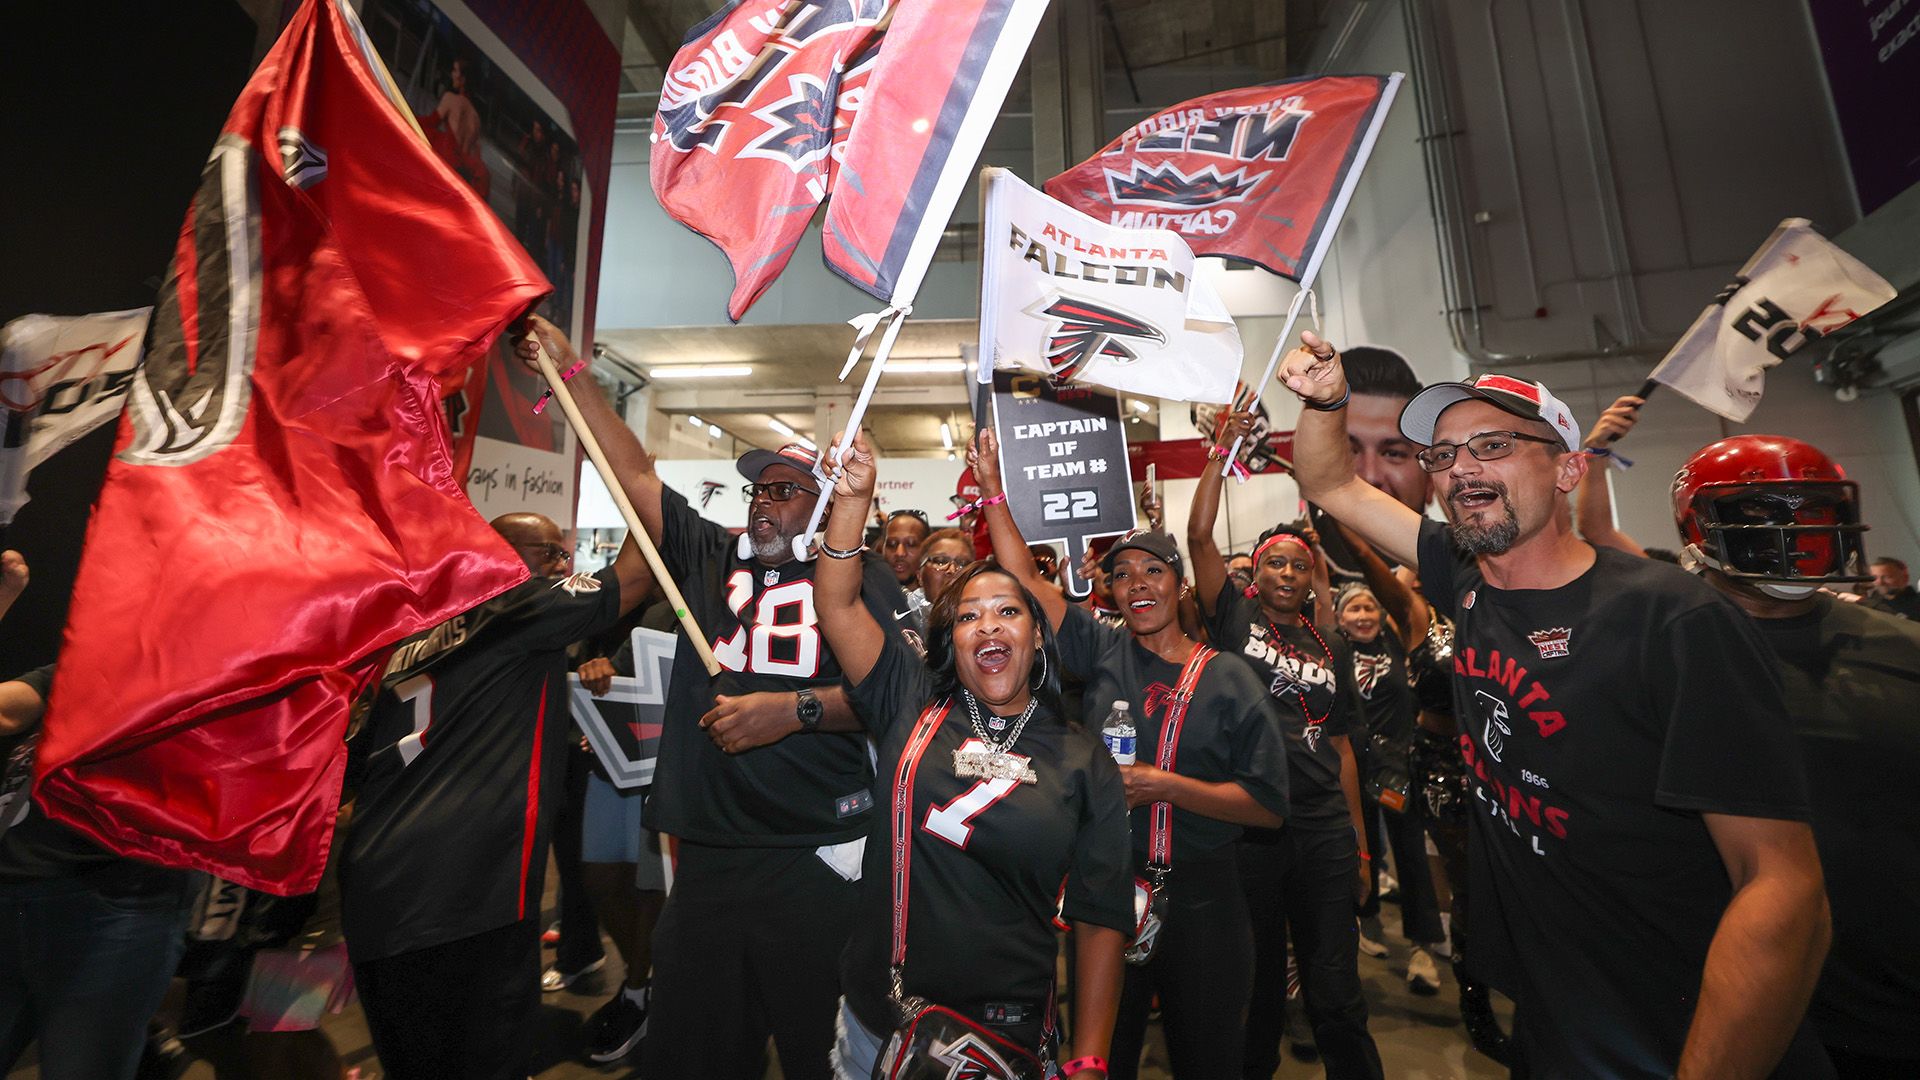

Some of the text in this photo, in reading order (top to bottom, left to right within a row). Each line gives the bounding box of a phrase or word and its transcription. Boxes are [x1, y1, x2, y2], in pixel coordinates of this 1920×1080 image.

[1009, 221, 1190, 293] FALCON
[1042, 222, 1168, 261] ATLANTA
[1013, 417, 1108, 440] CAPTAIN
[1048, 440, 1077, 457] OF
[505, 463, 516, 491] in
[523, 467, 563, 501] fashion
[1023, 458, 1108, 480] TEAM #
[877, 480, 914, 490] artner
[1043, 490, 1098, 521] 22
[711, 568, 821, 680] 18
[1540, 642, 1567, 653] NEST
[1454, 646, 1568, 738] LANTA
[921, 737, 1031, 850] 7
[1521, 768, 1550, 789] 1966
